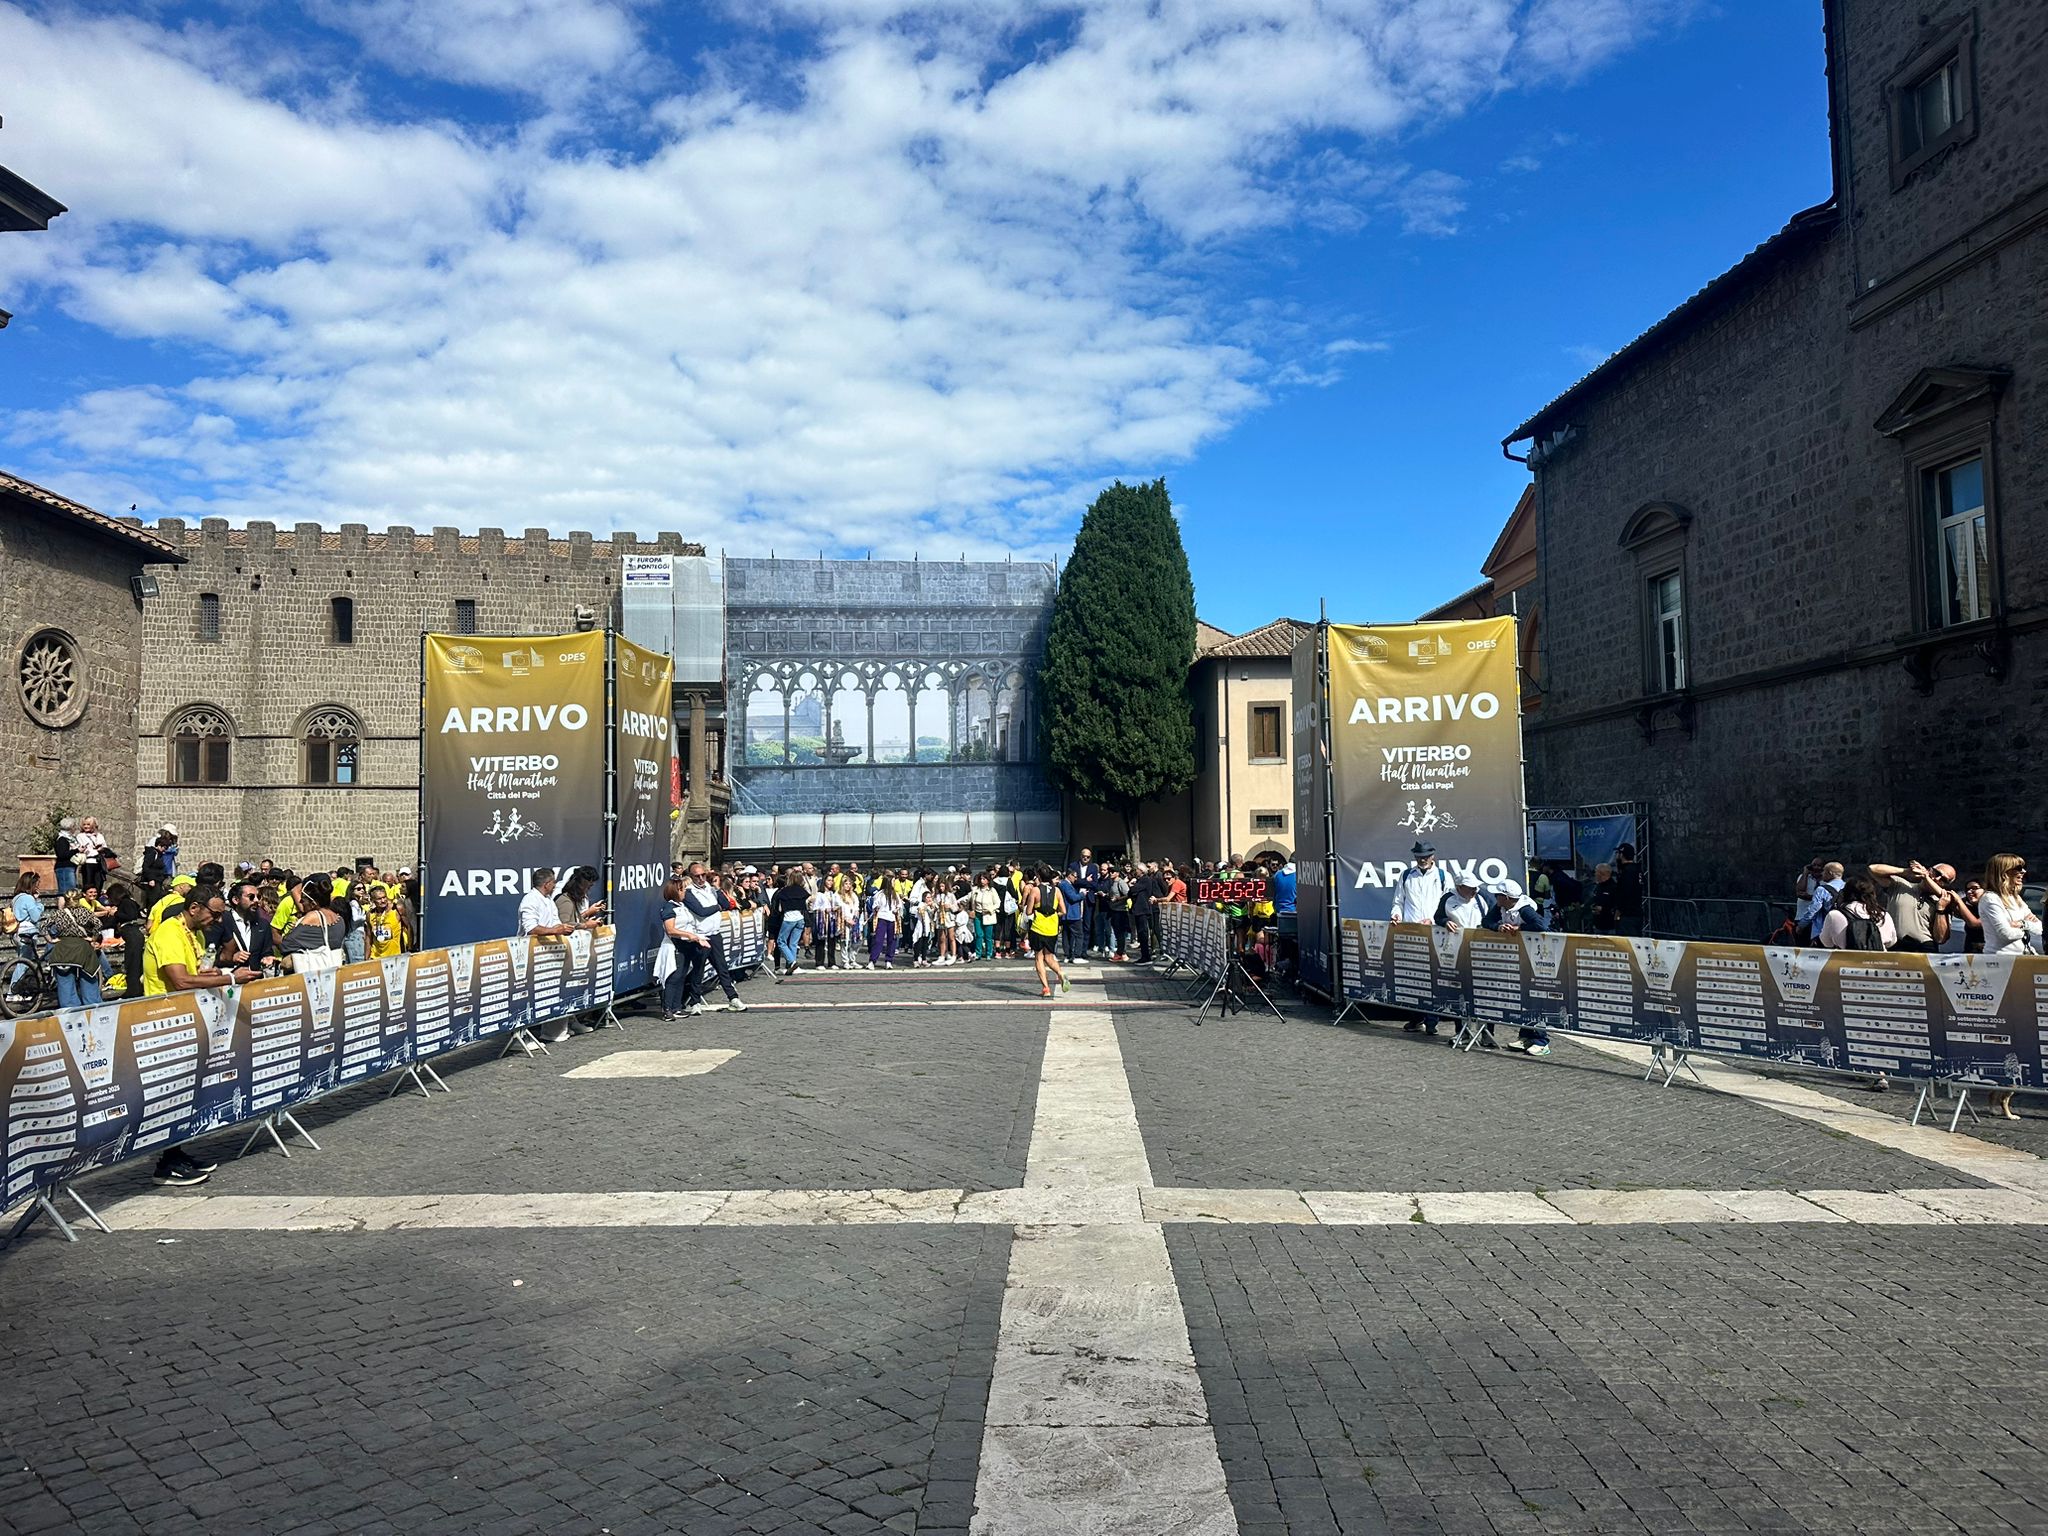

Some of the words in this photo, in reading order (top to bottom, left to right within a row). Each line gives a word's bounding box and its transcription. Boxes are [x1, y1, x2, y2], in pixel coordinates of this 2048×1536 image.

[1467, 639, 1497, 650] OPES
[559, 652, 586, 663] OPES
[1348, 692, 1500, 724] ARRIVO
[441, 704, 588, 733] ARRIVO
[622, 709, 668, 740] ARRIVO
[470, 754, 559, 772] VITERBO
[1381, 744, 1471, 763] VITERBO
[467, 772, 496, 792] Half
[498, 772, 558, 790] Marathon
[1380, 763, 1409, 783] Half
[1411, 762, 1471, 781] Marathon
[487, 791, 506, 799] Città
[507, 791, 520, 799] dei
[522, 790, 540, 800] Papi
[1401, 782, 1420, 790] Città
[1421, 782, 1434, 790] dei
[1435, 781, 1454, 790] Papi
[439, 866, 583, 897] ARRI
[618, 862, 664, 892] ARRIVO
[1297, 861, 1325, 888] ARRIVO
[1354, 858, 1508, 888] ARVO
[1199, 882, 1266, 899] 02:25:22
[1956, 992, 1994, 1001] VITERBO
[82, 1058, 107, 1071] VITERBO
